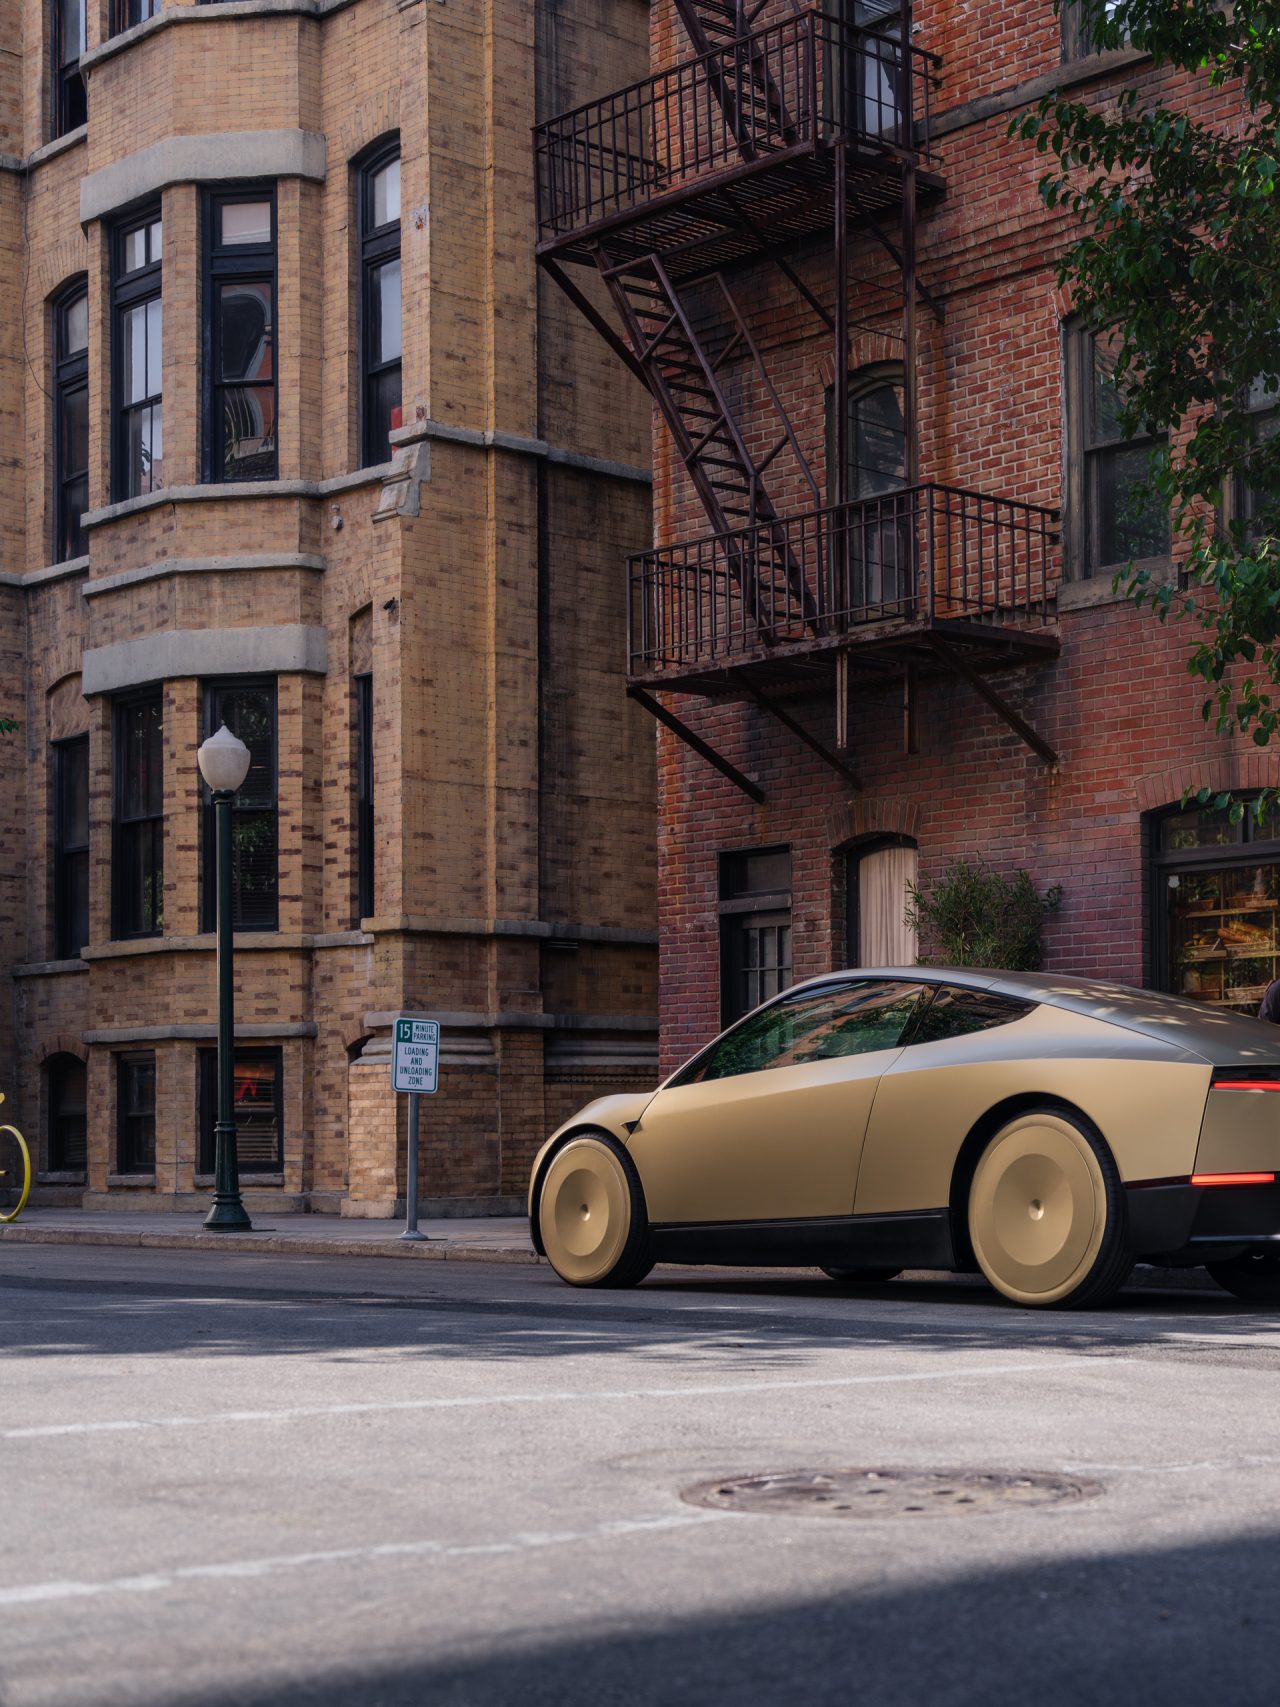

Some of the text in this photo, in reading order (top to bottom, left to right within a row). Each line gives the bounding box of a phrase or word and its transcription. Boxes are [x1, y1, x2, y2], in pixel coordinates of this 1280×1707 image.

[399, 1023, 411, 1039] 15
[415, 1024, 435, 1033] MINUTE
[413, 1033, 436, 1042] PARKING
[404, 1046, 429, 1056] LOADING
[410, 1057, 423, 1066] AND
[399, 1066, 433, 1076] UNLOADING
[408, 1076, 423, 1086] ZONE
